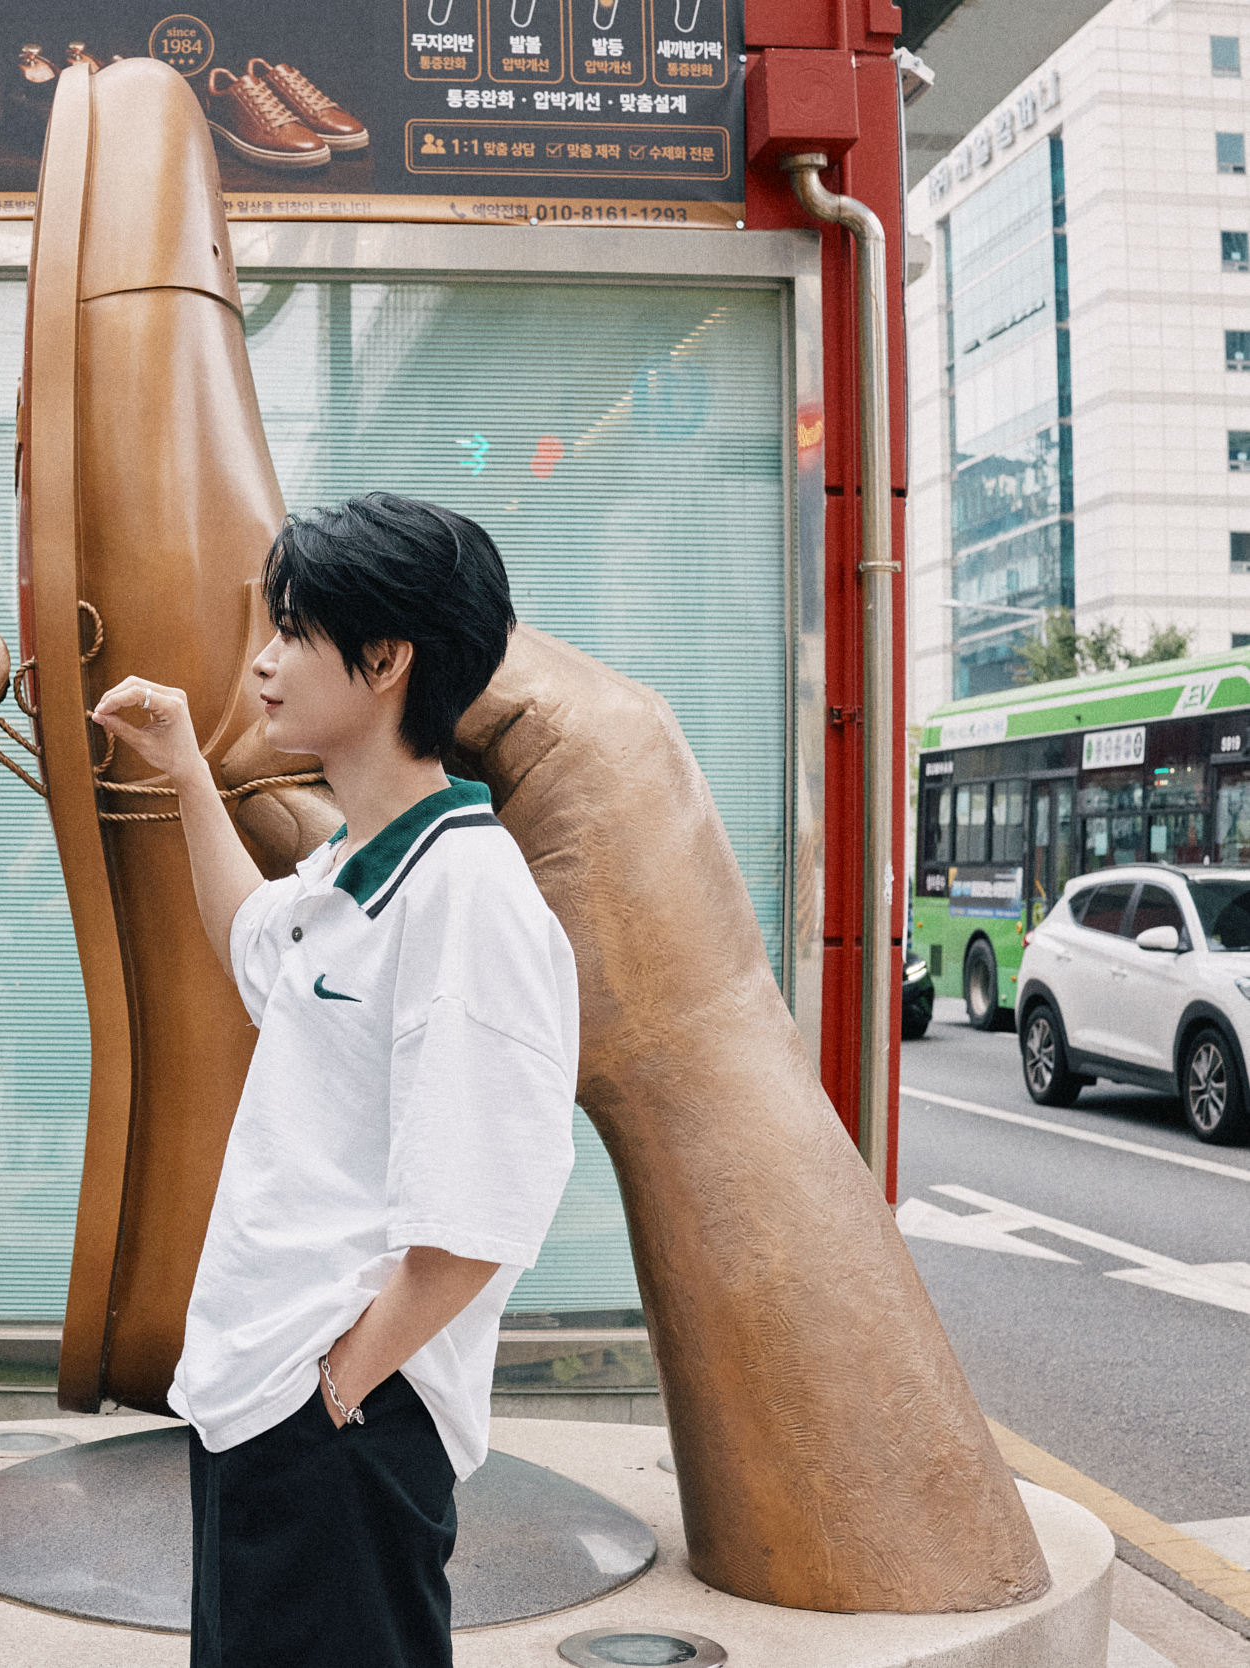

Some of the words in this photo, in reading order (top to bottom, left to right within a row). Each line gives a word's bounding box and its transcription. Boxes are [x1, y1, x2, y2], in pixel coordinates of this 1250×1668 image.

[166, 26, 197, 37] since
[161, 38, 203, 54] 1984
[410, 33, 474, 53] 무지외반
[509, 35, 542, 55] 발볼
[591, 37, 624, 57] 발등
[656, 40, 722, 60] 새끼발가락
[418, 56, 467, 71] 통증완화
[502, 57, 550, 73] 압박개선
[584, 59, 632, 75] 압박개선
[666, 62, 714, 78] 통증완화
[446, 89, 515, 110] 통증완화
[533, 91, 601, 112] 압박개선
[619, 93, 687, 114] 맞춤설계
[451, 138, 479, 156] 1:1
[483, 140, 509, 157] 맞춤
[510, 141, 536, 157] 상담
[566, 142, 593, 159] 맞춤
[595, 143, 621, 160] 제작
[648, 144, 687, 162] 수제화
[689, 146, 715, 162] 전문
[237, 201, 273, 214] 일상을
[278, 201, 314, 214] 되찾아
[472, 203, 529, 220] 예약전화
[536, 205, 688, 224] 010-8161-1293
[1183, 682, 1215, 709] EV
